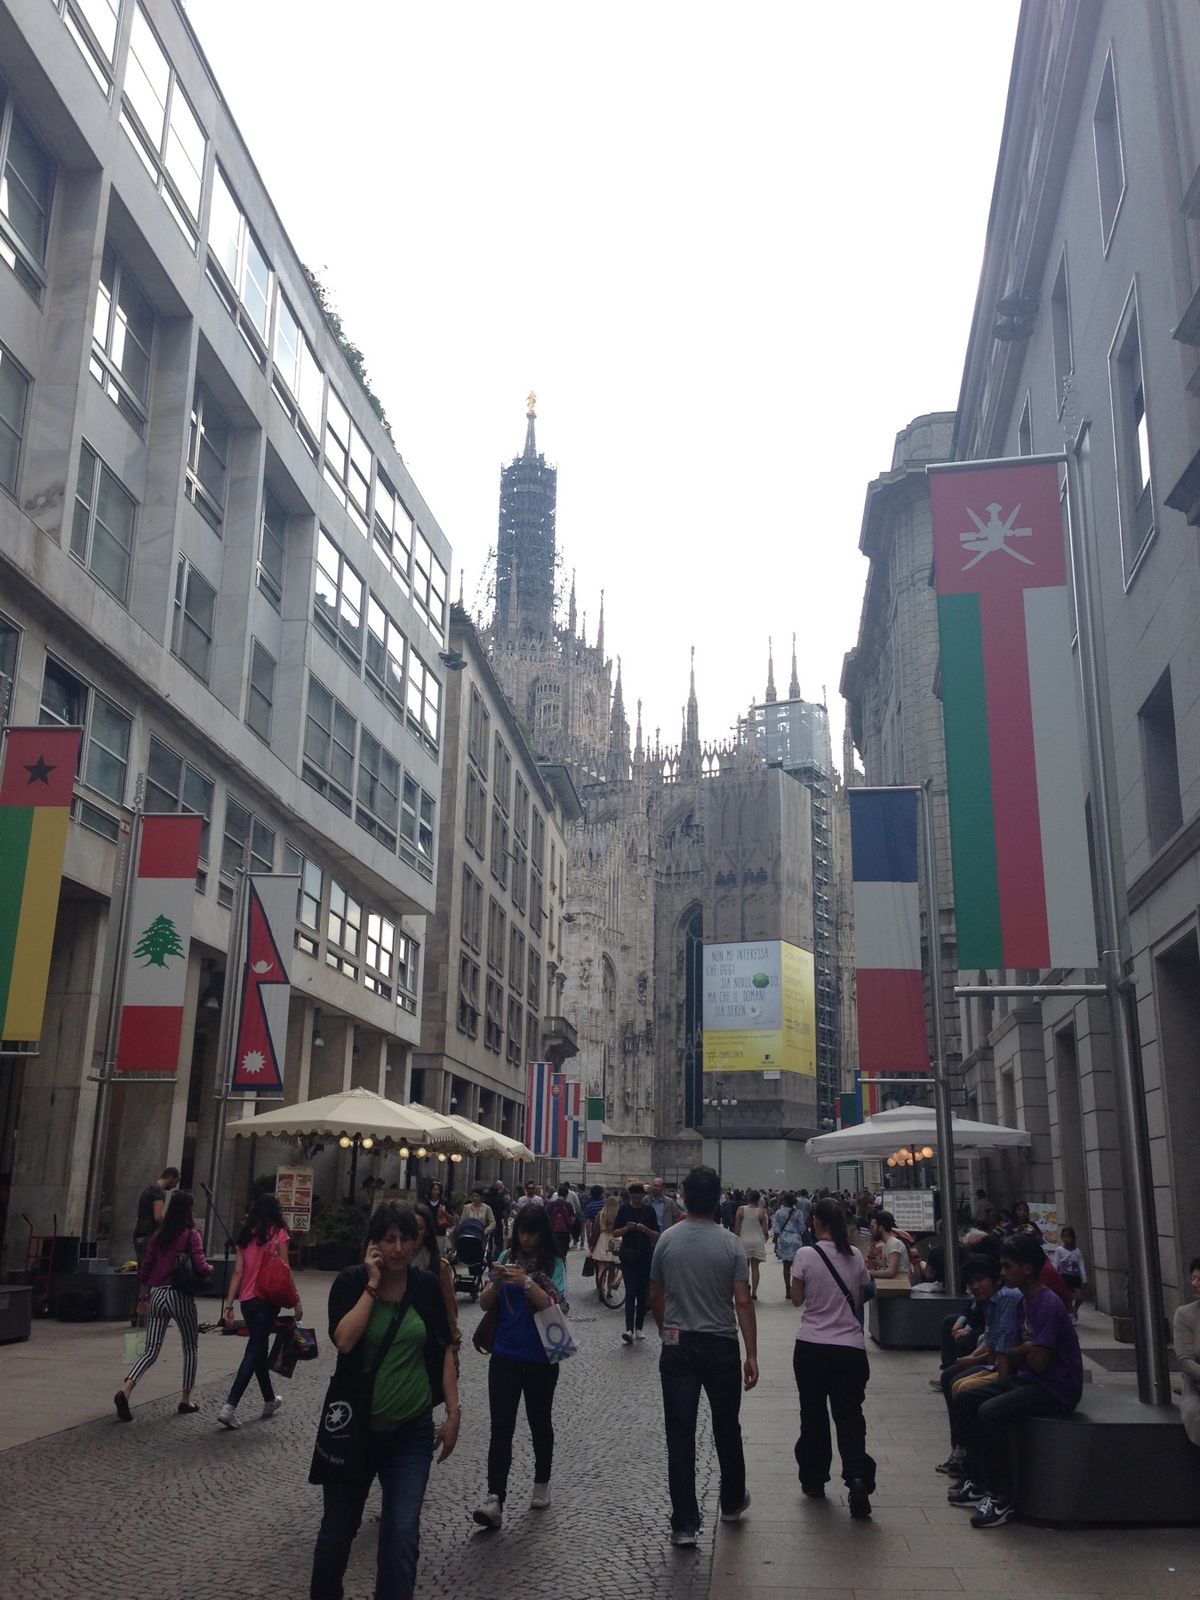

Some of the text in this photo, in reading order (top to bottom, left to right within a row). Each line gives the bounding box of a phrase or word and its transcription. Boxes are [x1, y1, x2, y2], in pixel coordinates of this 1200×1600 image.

[711, 950, 724, 962] NON
[736, 948, 769, 961] INTERESSA
[706, 963, 735, 977] CHE OGGI
[721, 977, 731, 989] SIA
[707, 991, 716, 1003] MA
[719, 991, 731, 1003] CHE
[743, 989, 766, 1002] DOMANI
[714, 1005, 725, 1018] SIA
